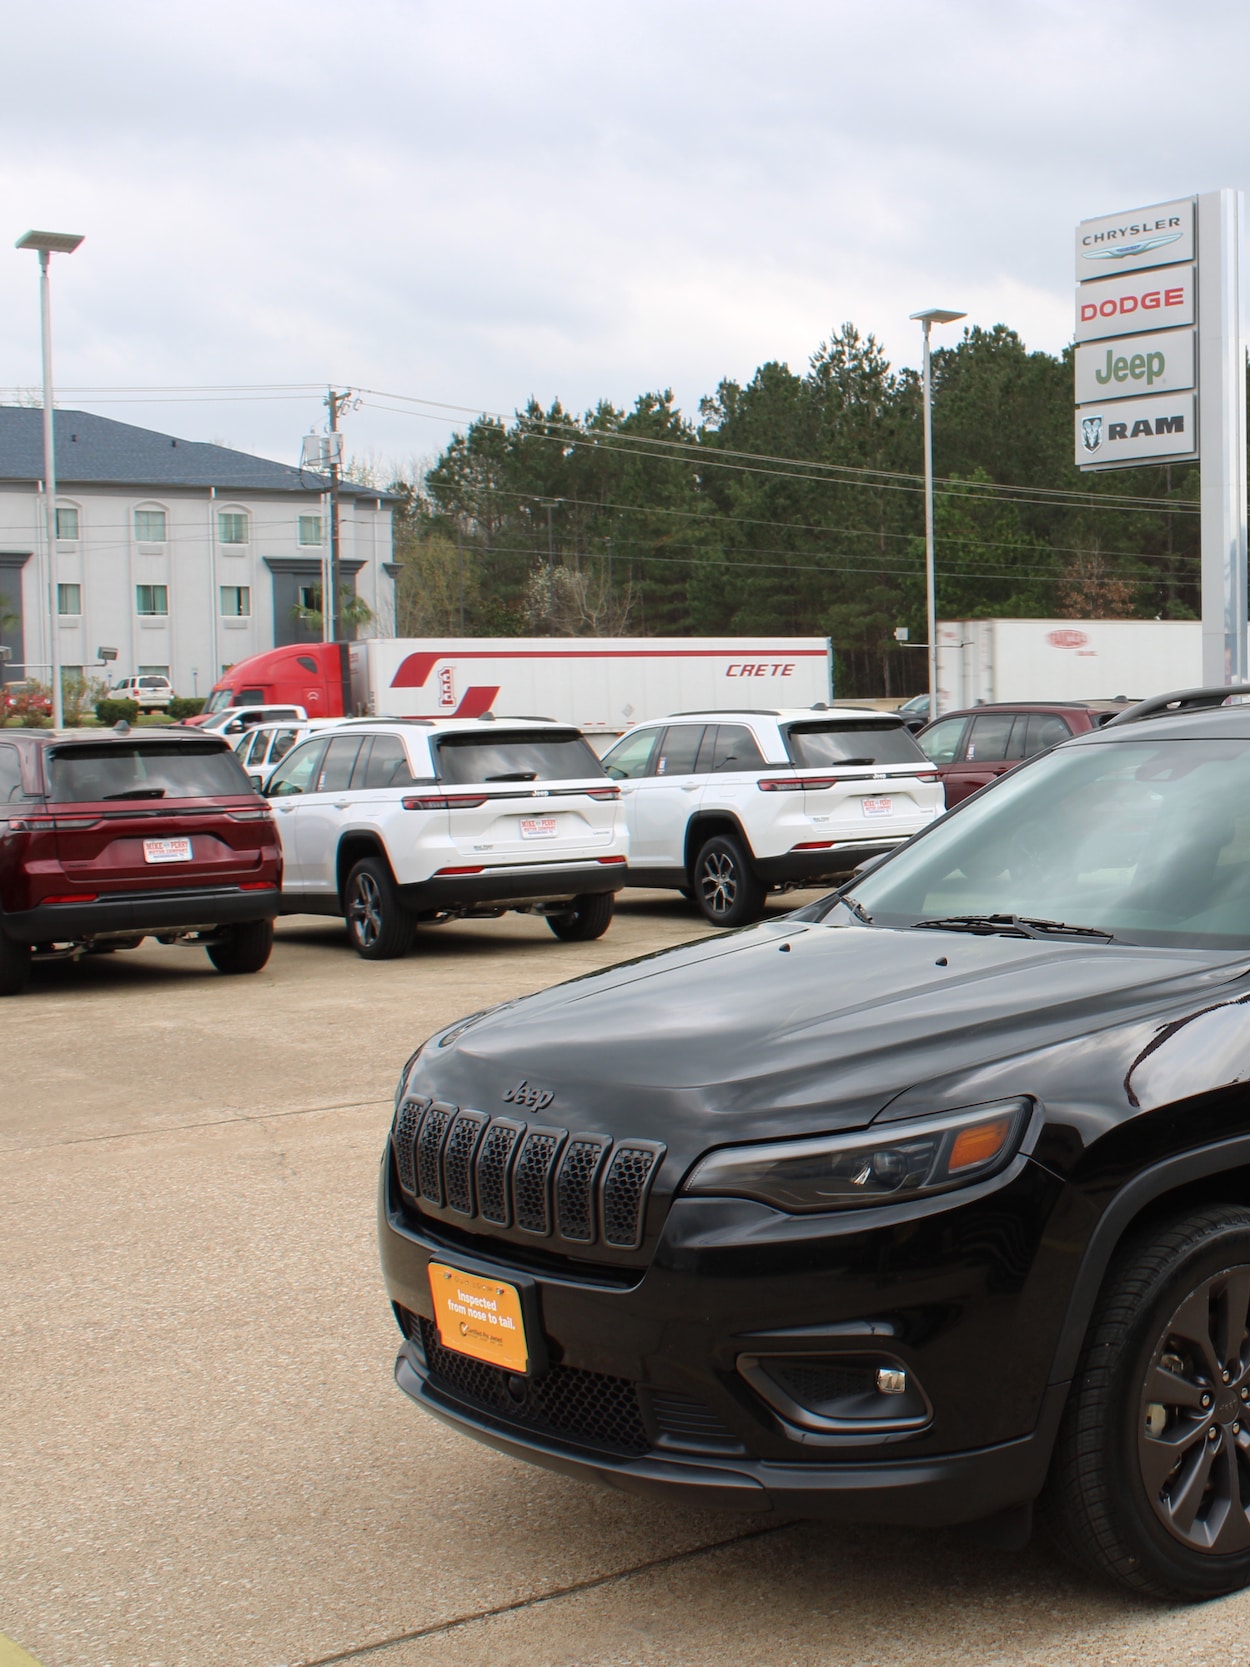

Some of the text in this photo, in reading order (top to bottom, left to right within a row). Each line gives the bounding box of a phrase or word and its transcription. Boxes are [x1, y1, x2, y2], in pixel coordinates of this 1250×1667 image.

[1082, 217, 1180, 246] CHRYSLER
[1081, 287, 1184, 322] DODGE
[1095, 350, 1165, 385] Jeep
[1108, 415, 1184, 441] RAM
[725, 664, 796, 677] CRETE
[502, 1080, 555, 1113] Jeep
[447, 1299, 516, 1330] from nose to tail.
[457, 1289, 497, 1311] Inspected
